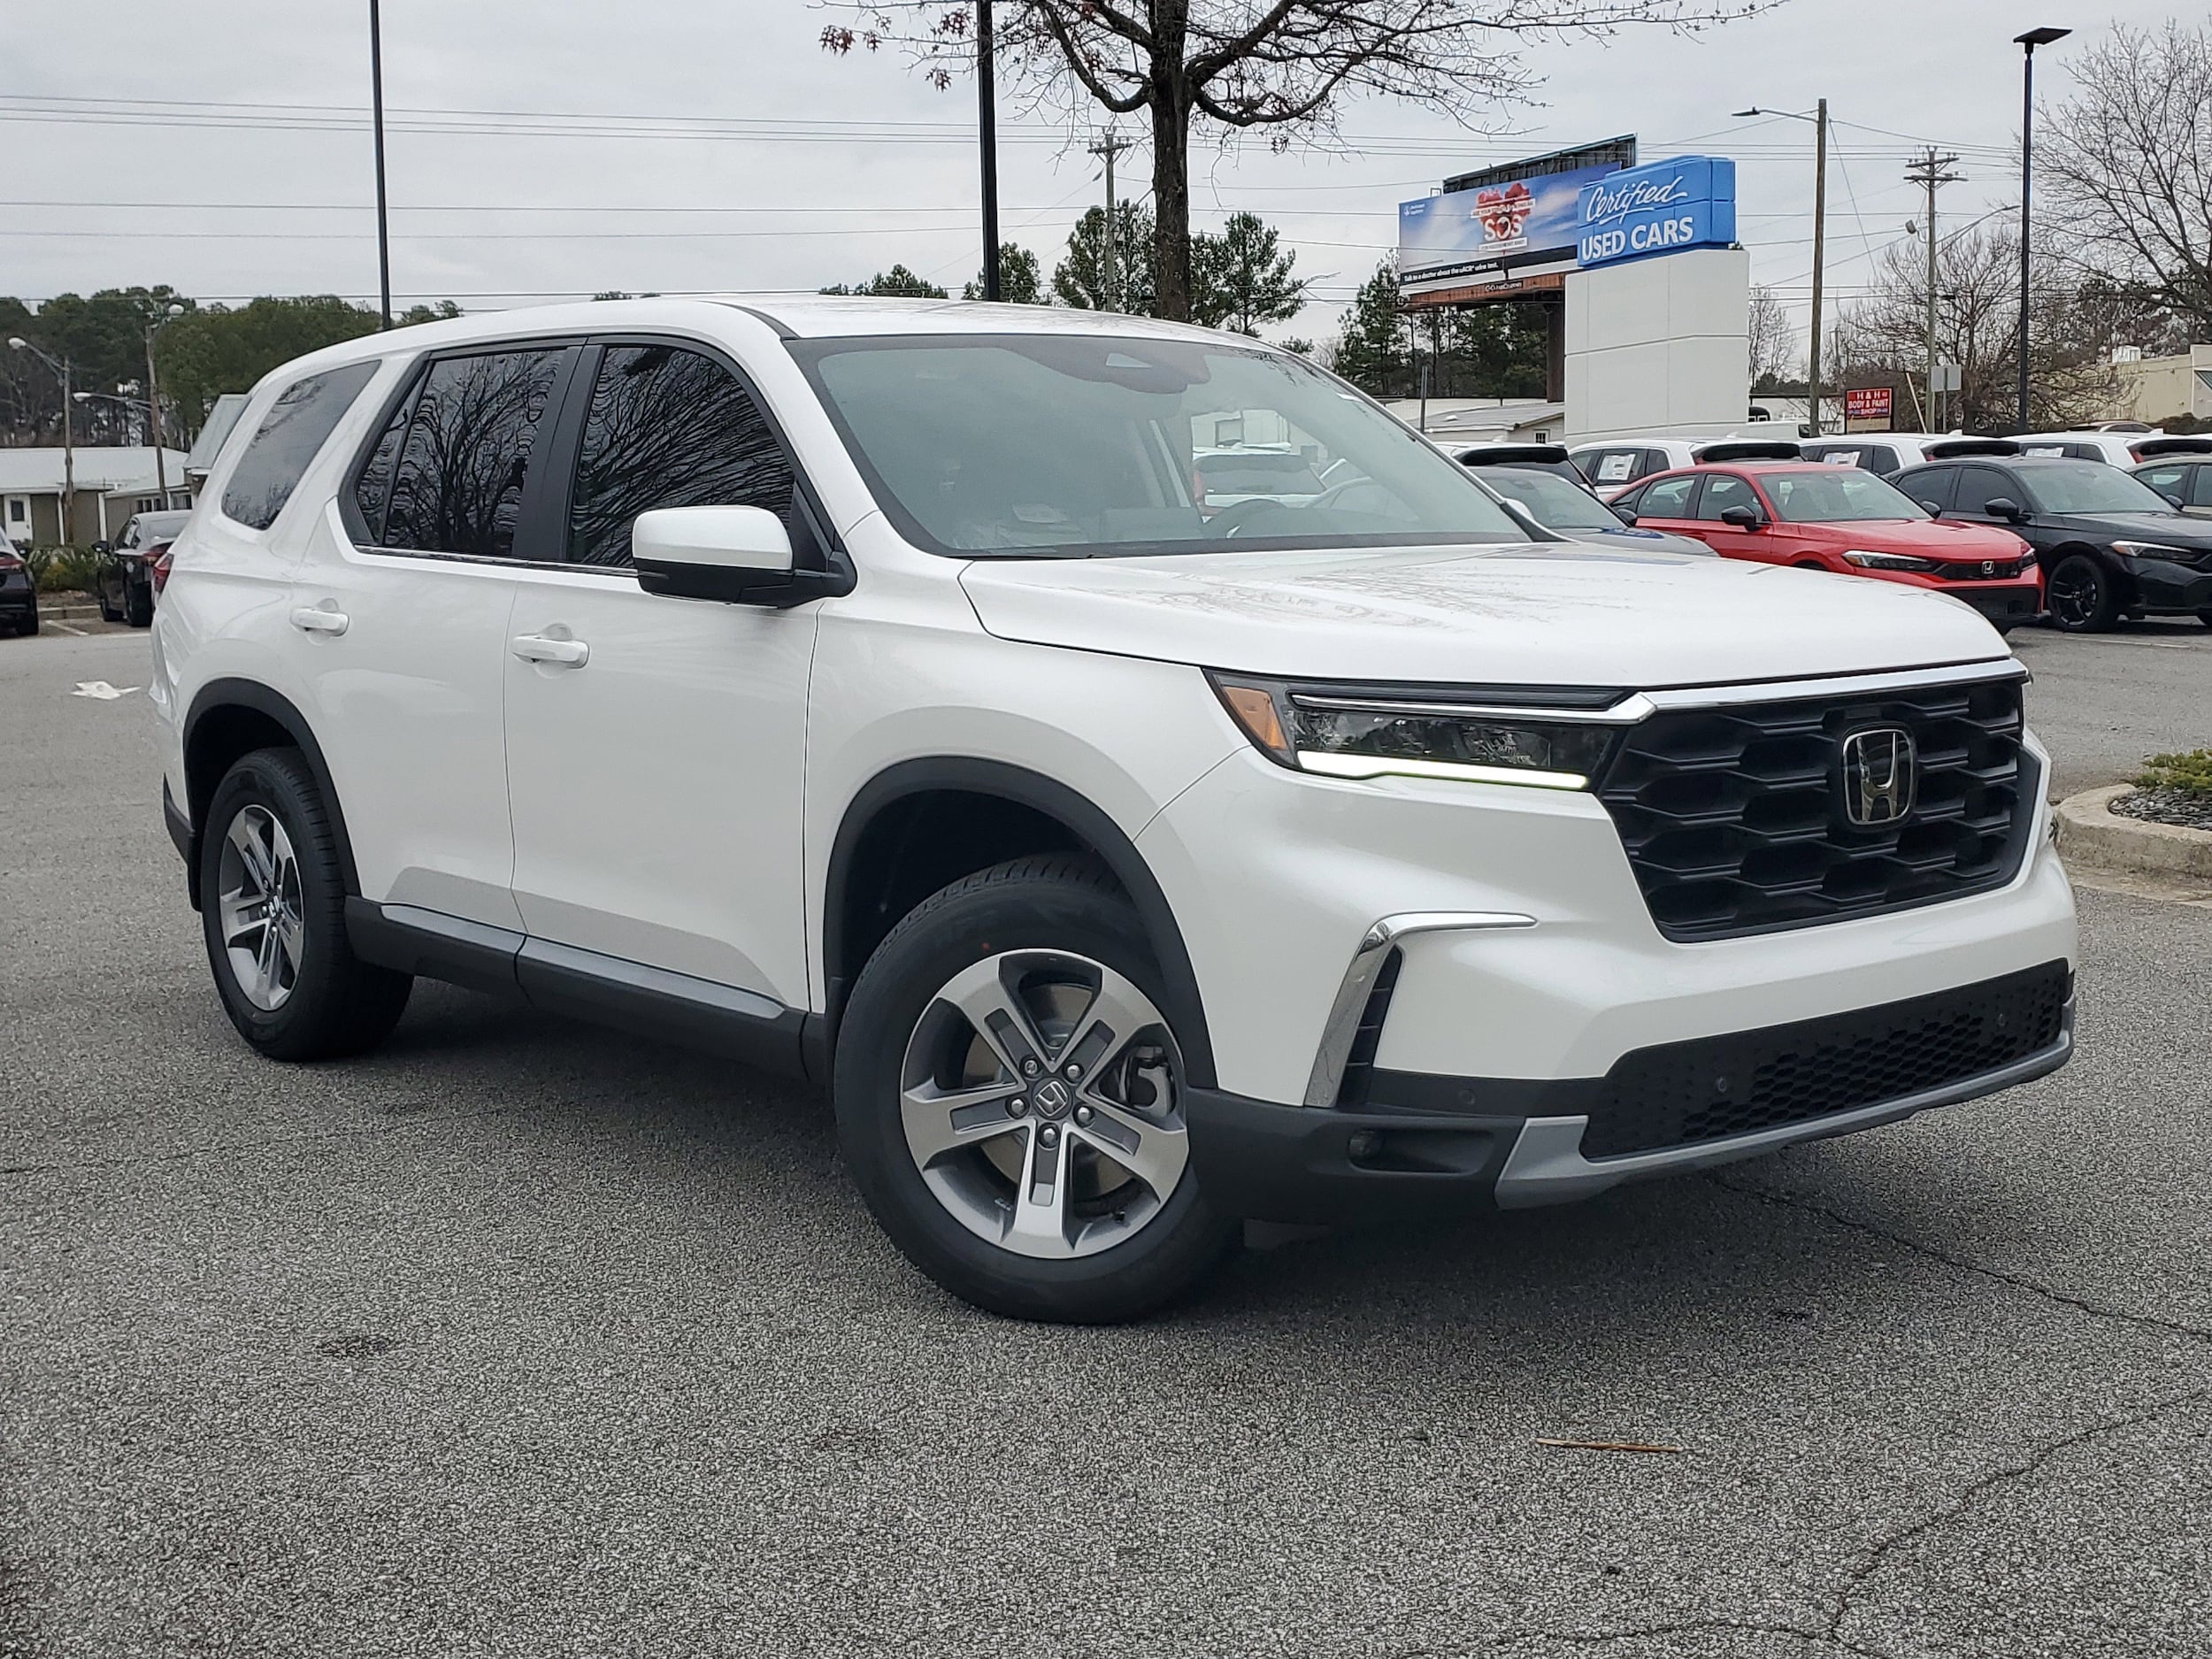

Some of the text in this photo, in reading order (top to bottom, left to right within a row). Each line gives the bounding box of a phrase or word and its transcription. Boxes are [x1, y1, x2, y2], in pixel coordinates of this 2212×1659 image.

[1586, 176, 1687, 225] Certified
[1484, 214, 1523, 241] SOS
[1582, 217, 1694, 261] USED CARS
[1848, 400, 1864, 409] BODY
[1872, 398, 1888, 407] PAINT
[1874, 390, 1880, 399] H
